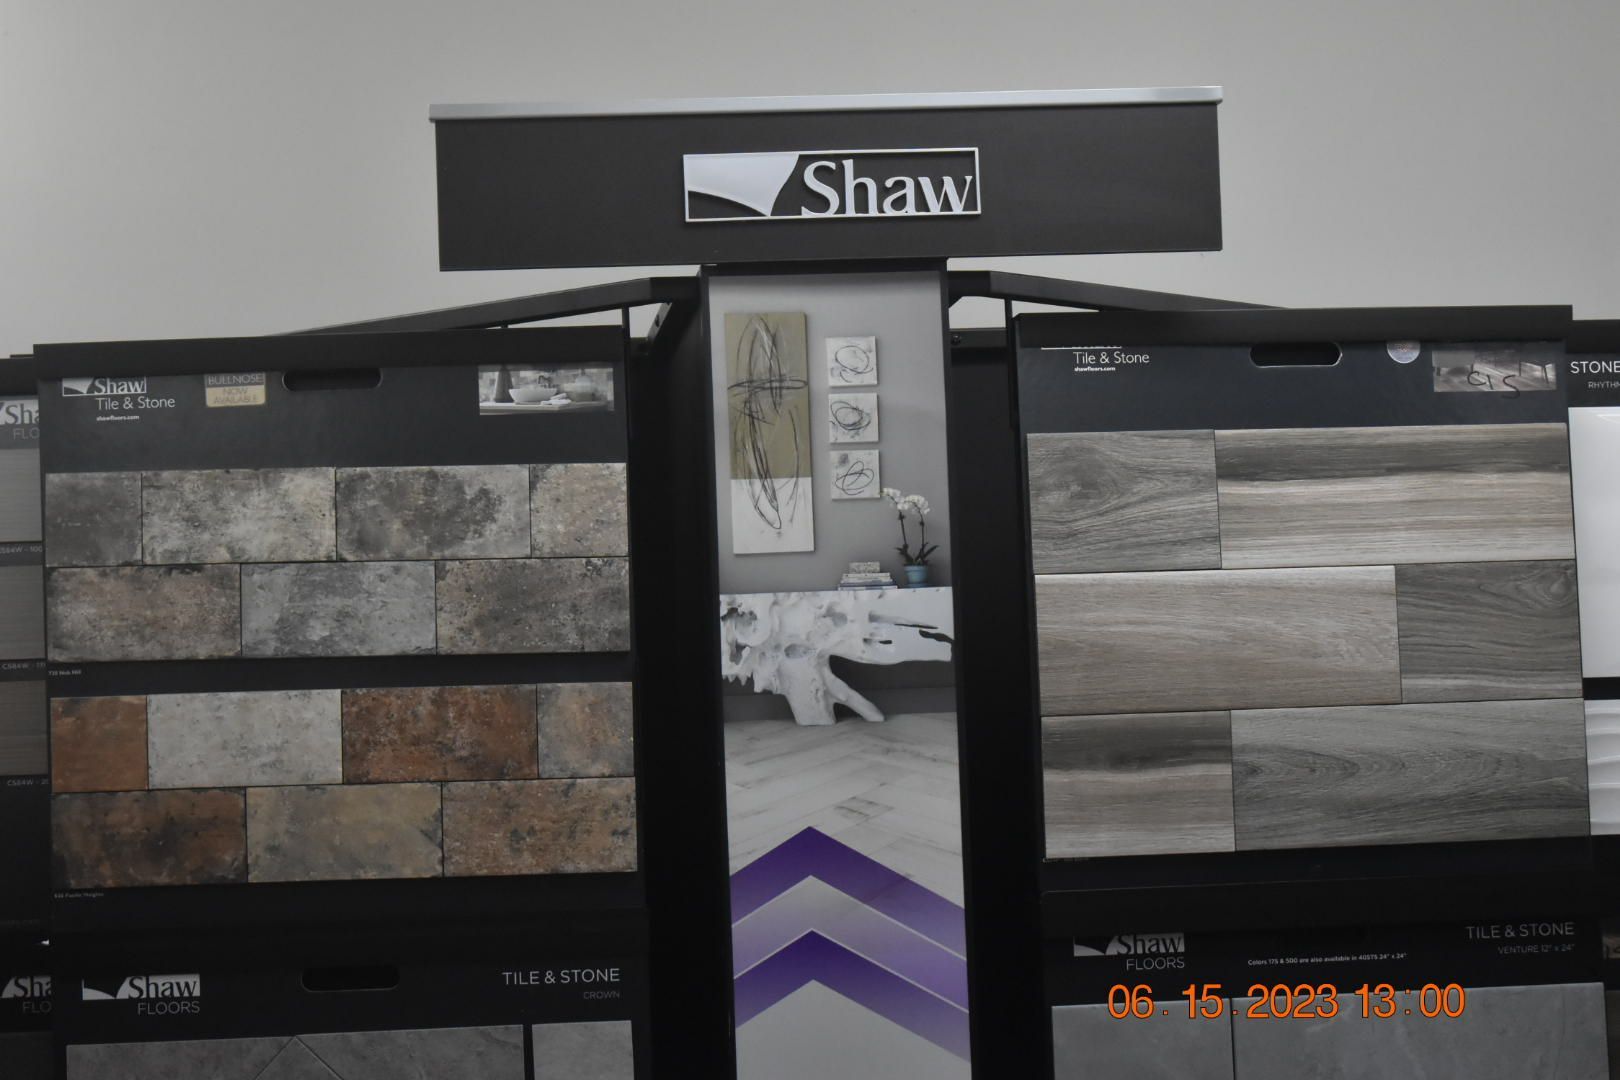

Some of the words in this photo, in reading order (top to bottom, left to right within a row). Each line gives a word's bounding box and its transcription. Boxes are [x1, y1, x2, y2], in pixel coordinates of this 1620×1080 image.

[801, 159, 972, 215] Shaw
[1073, 352, 1096, 364] Tile
[1100, 352, 1109, 364] &
[1114, 351, 1149, 364] Stone
[1570, 361, 1620, 374] STONE
[208, 373, 265, 385] BULLNOSE
[94, 377, 144, 396] Shaw
[96, 397, 119, 410] Tile
[123, 397, 133, 410] &
[138, 396, 176, 409] Stone
[1466, 925, 1502, 939] TILE
[1504, 924, 1516, 938] &
[1520, 922, 1576, 937] STONE
[1119, 934, 1184, 956] Shaw
[1498, 944, 1539, 954] VENTURE
[1126, 957, 1185, 971] FLOORS
[1248, 958, 1267, 966] Colors
[1324, 955, 1350, 963] available
[502, 970, 540, 985] TILE
[544, 970, 556, 985] &
[560, 968, 620, 984] STONE
[128, 973, 198, 999] Shaw
[583, 990, 620, 1000] CROWN
[137, 1000, 200, 1016] FLOORS
